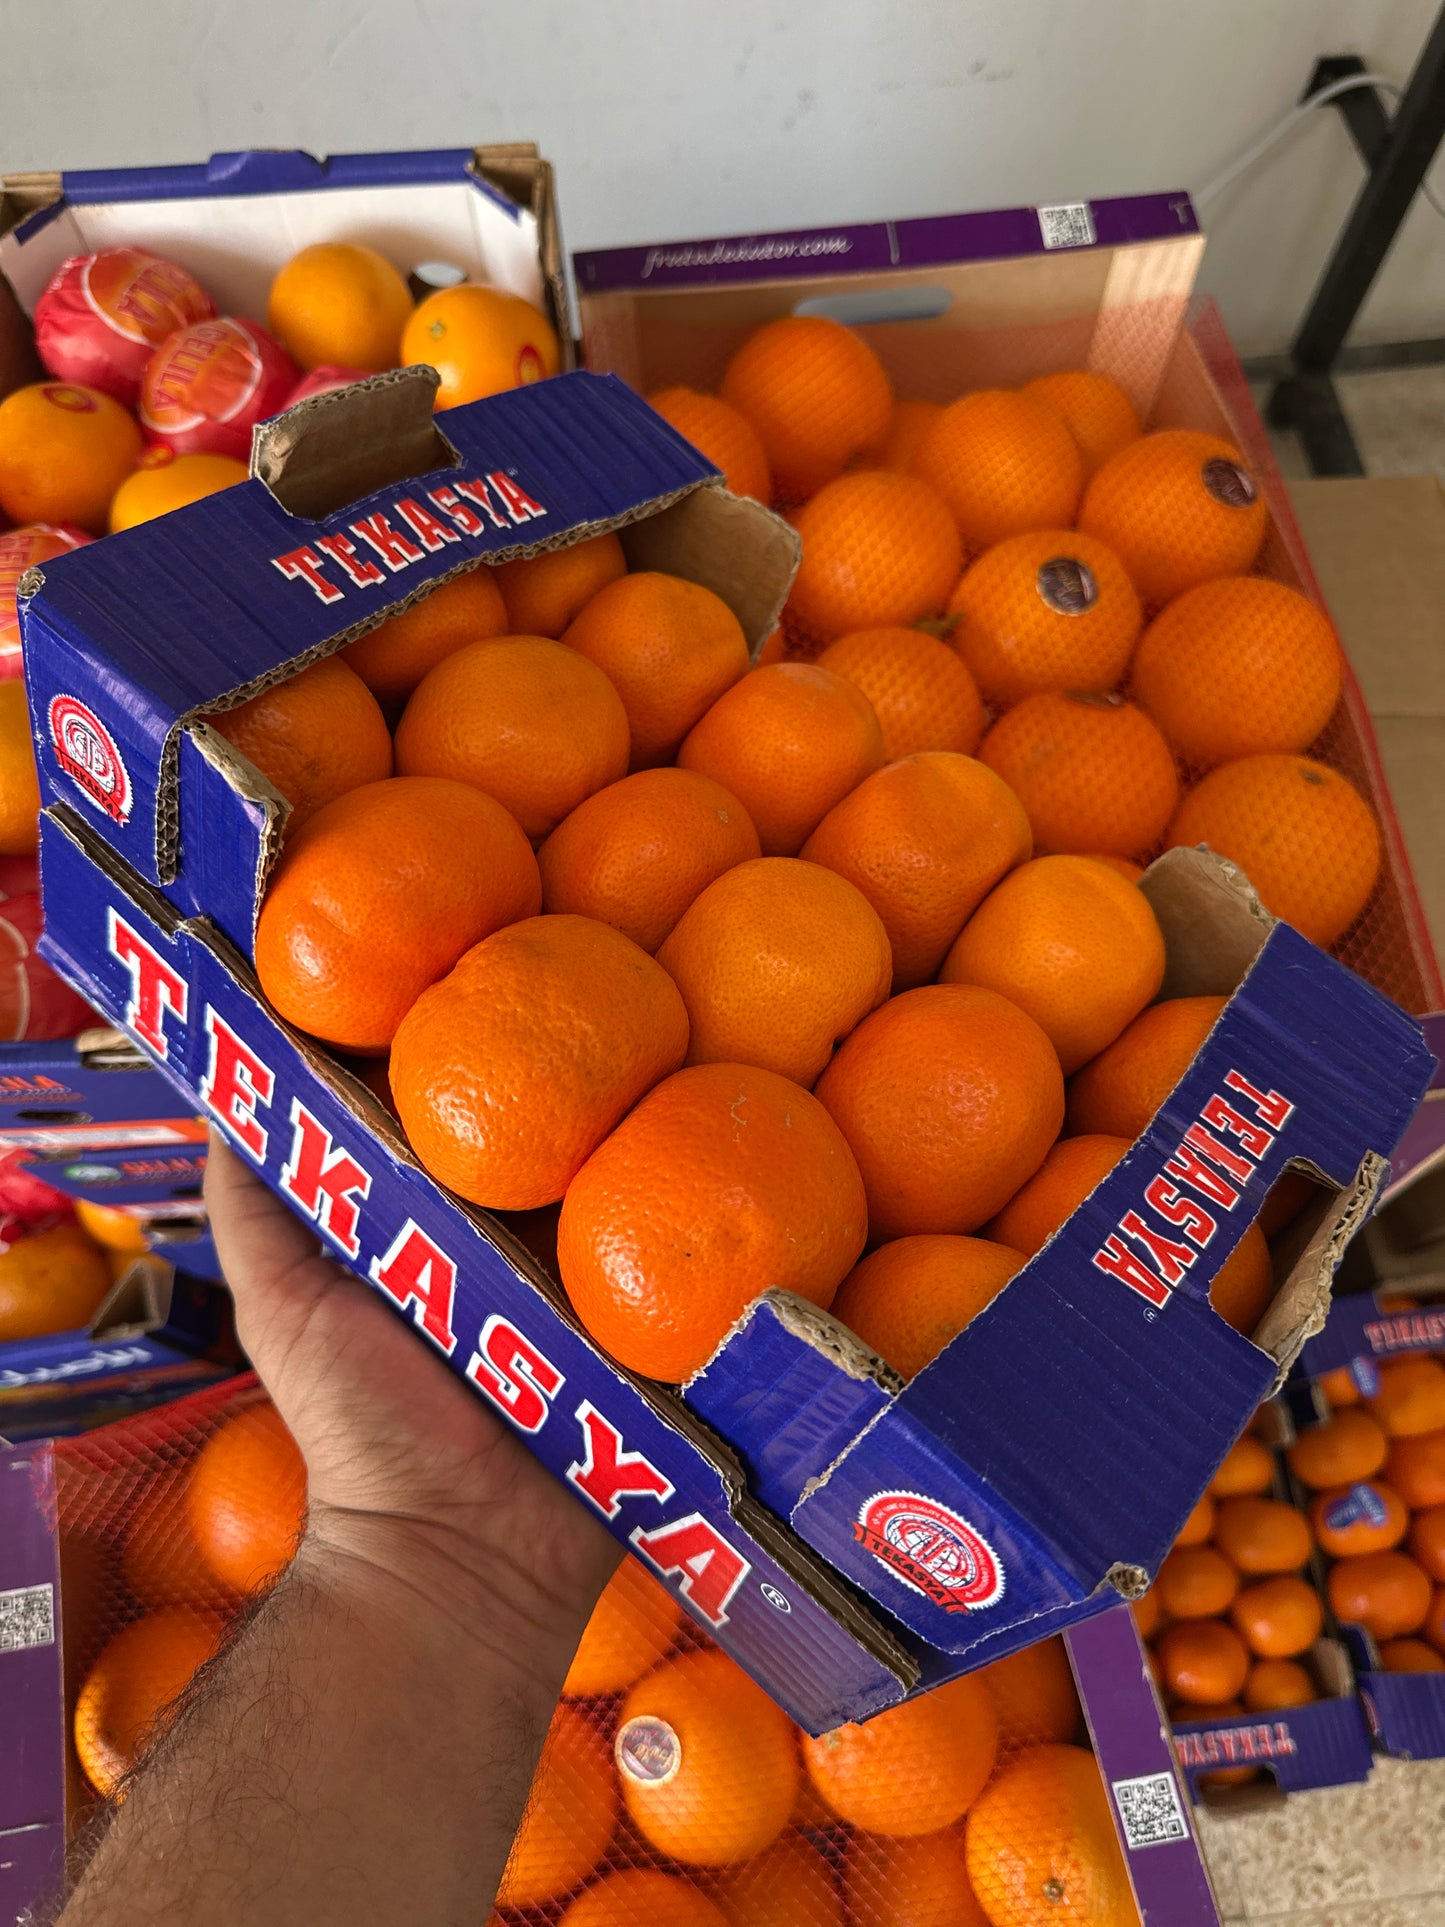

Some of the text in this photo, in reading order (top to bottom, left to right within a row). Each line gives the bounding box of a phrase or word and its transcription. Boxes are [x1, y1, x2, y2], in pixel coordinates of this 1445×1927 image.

[270, 472, 547, 605] TEKASYA
[67, 761, 114, 813] TEKASYA
[1092, 1069, 1295, 1309] TEKASYA
[107, 905, 751, 1629] TEKASYA
[872, 1539, 946, 1600] TEKASYA
[1172, 1721, 1298, 1767] TEKASYA
